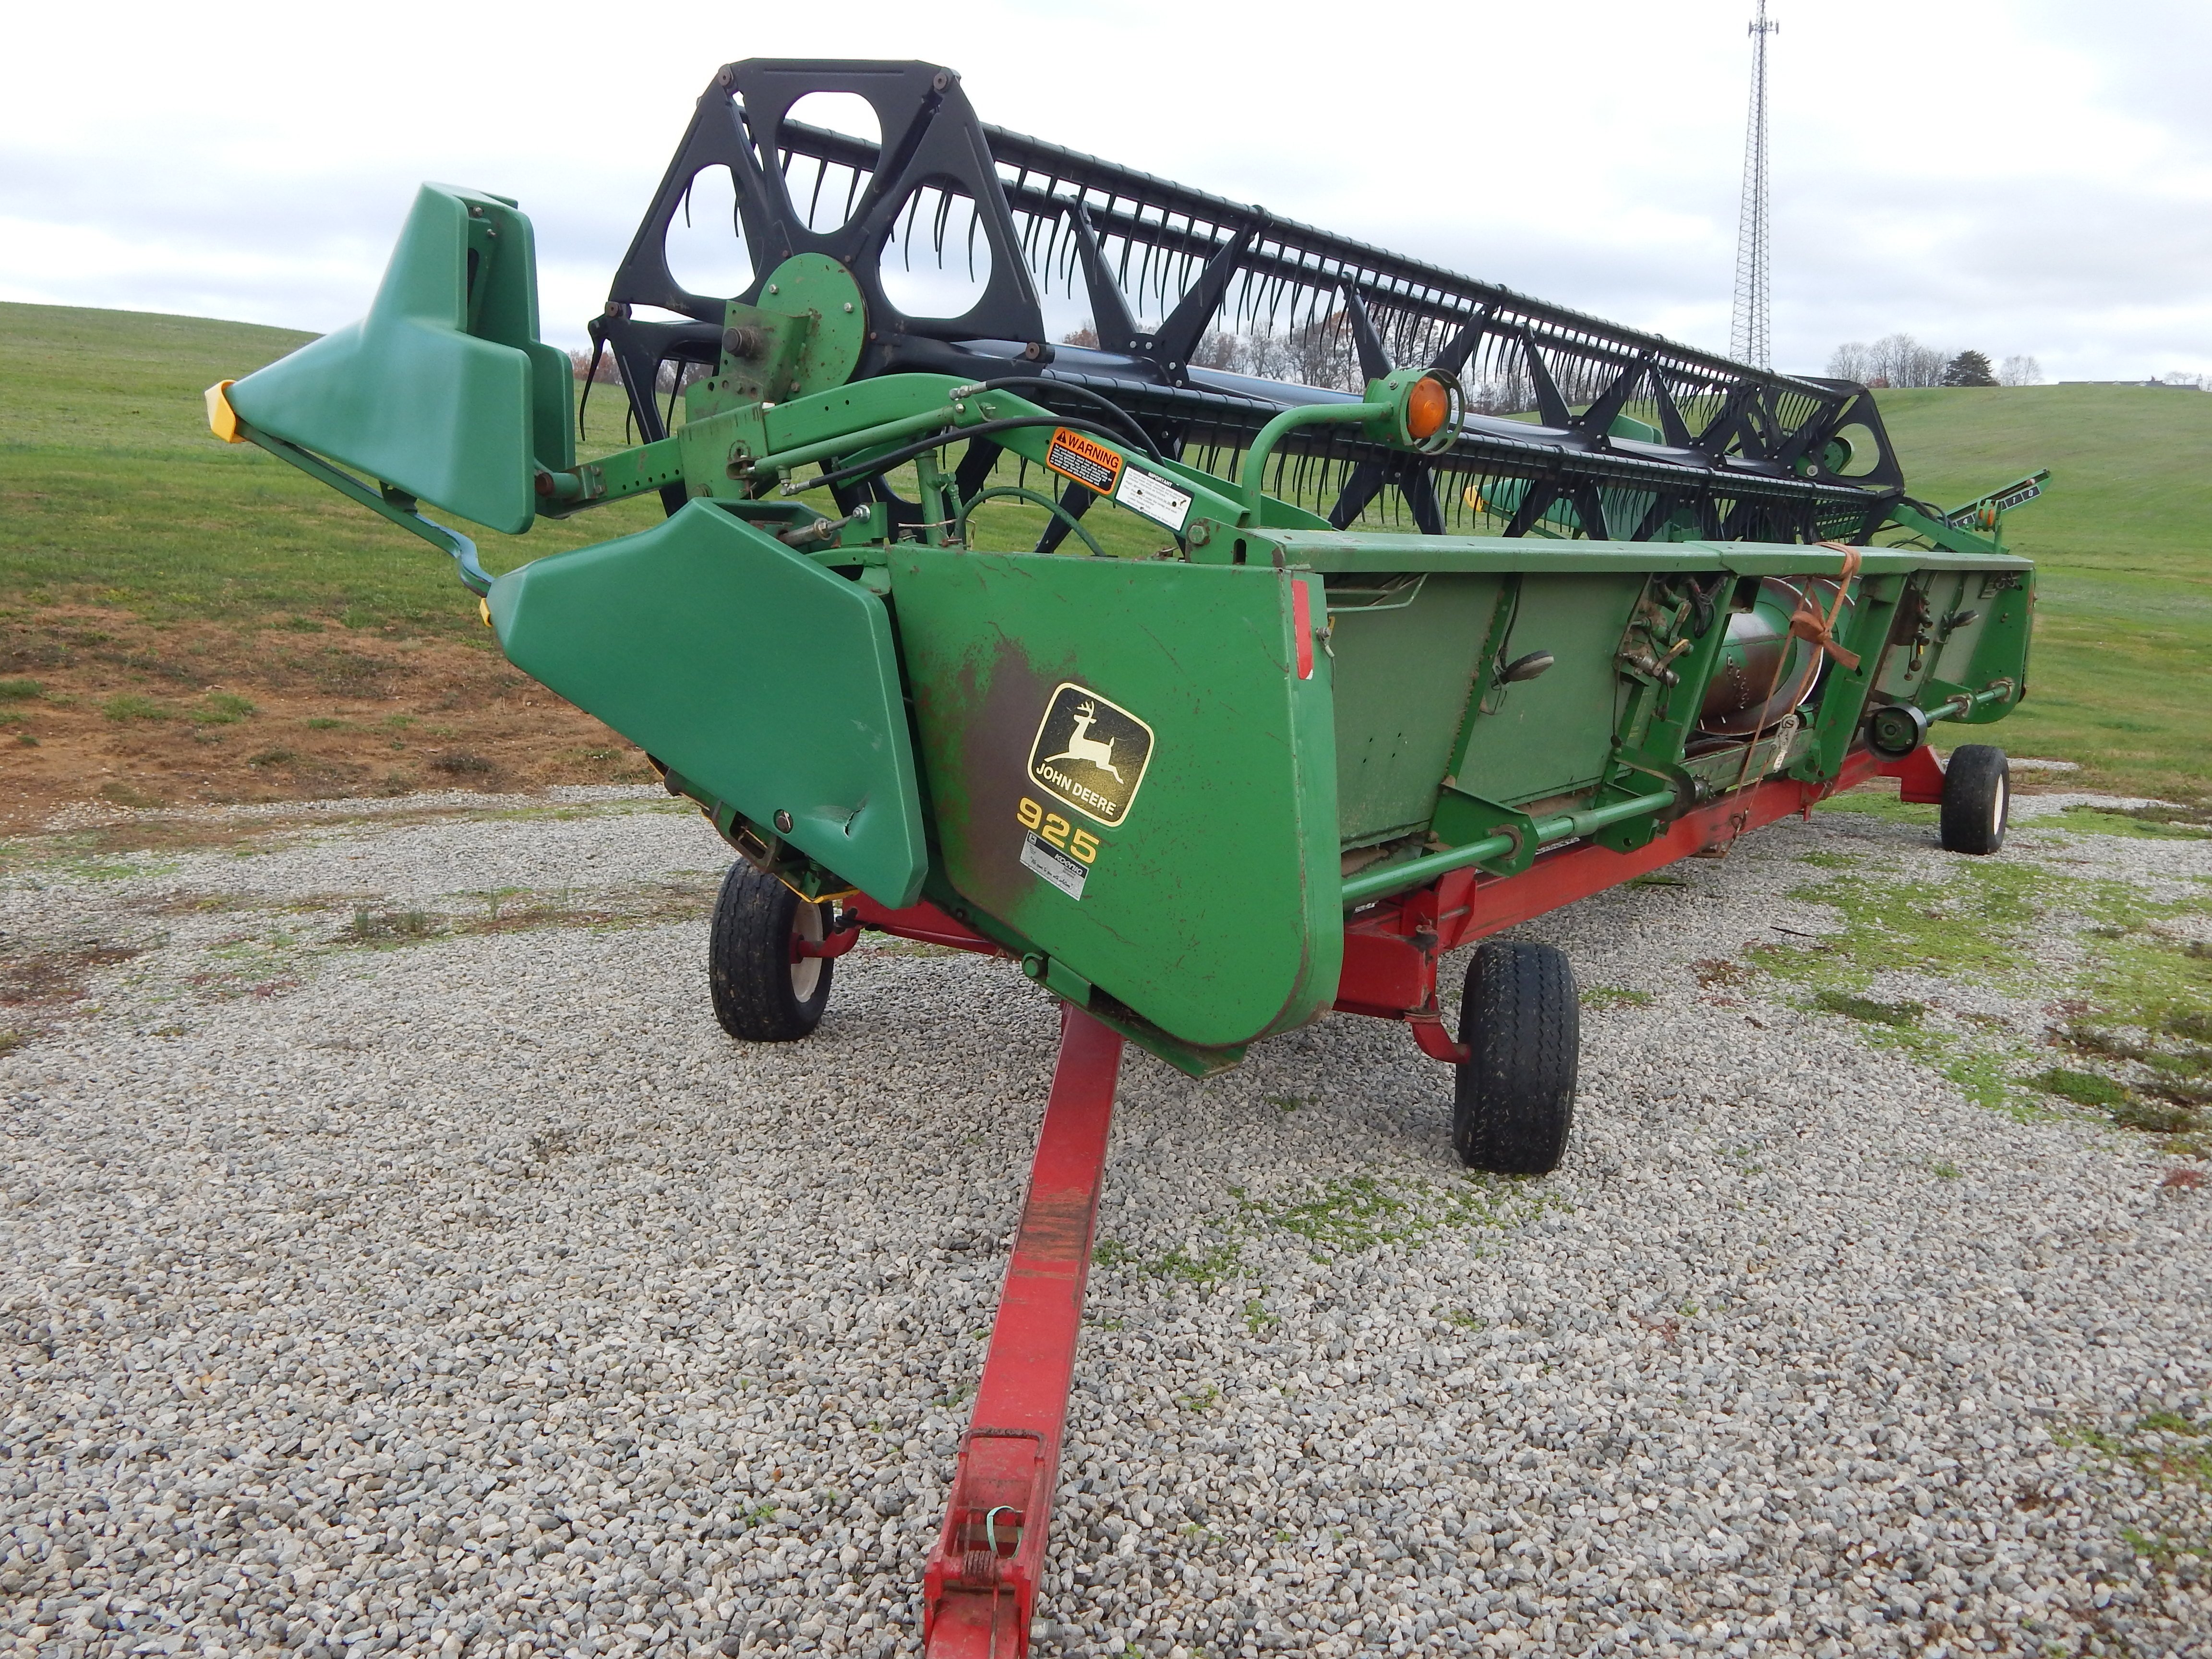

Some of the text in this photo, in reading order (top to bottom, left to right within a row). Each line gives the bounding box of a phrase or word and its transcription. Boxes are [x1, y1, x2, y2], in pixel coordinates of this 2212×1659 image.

[1069, 434, 1119, 469] WARNING
[1148, 471, 1173, 487] IMPORTANT
[1036, 763, 1117, 816] JOHN DEERE
[1017, 797, 1100, 864] 925
